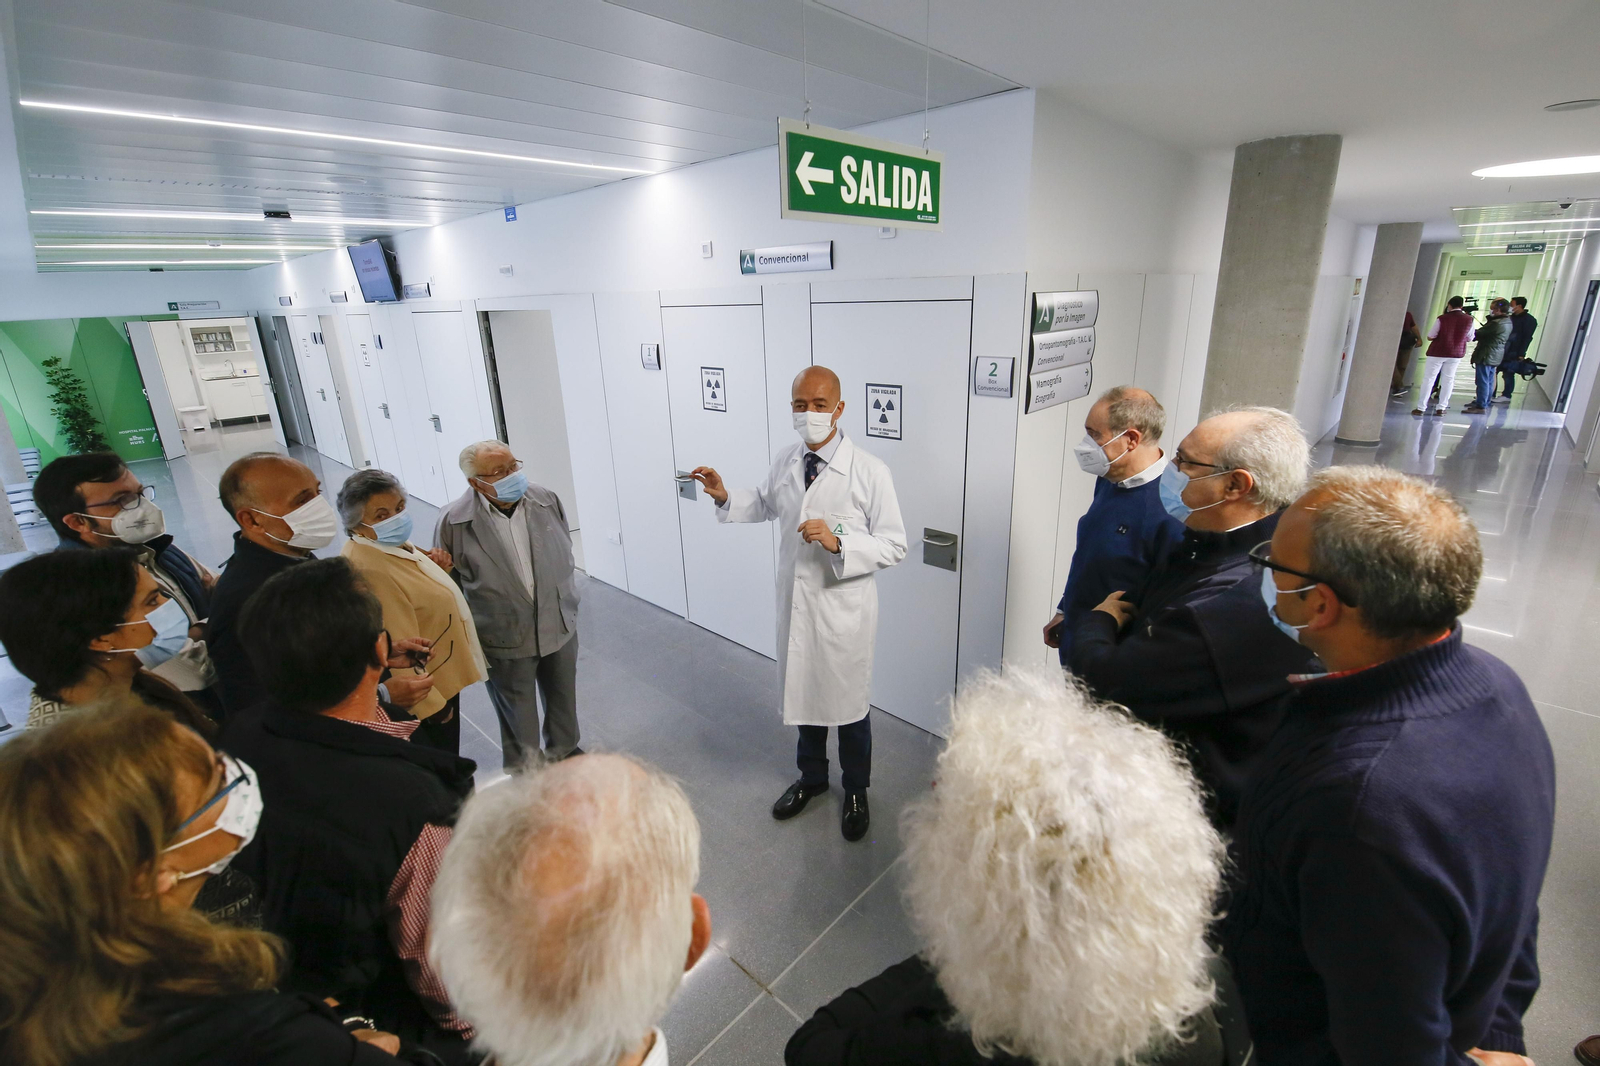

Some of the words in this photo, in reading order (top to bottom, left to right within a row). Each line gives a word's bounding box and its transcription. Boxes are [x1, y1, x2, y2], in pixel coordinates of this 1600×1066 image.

[840, 155, 933, 212] SALIDA
[758, 252, 809, 265] Convencional
[1055, 316, 1064, 326] por
[1069, 313, 1086, 324] Imagen
[1037, 354, 1064, 366] Convencional
[988, 362, 998, 377] 2
[1036, 375, 1062, 389] Mamografía
[1035, 391, 1056, 404] Ecografía
